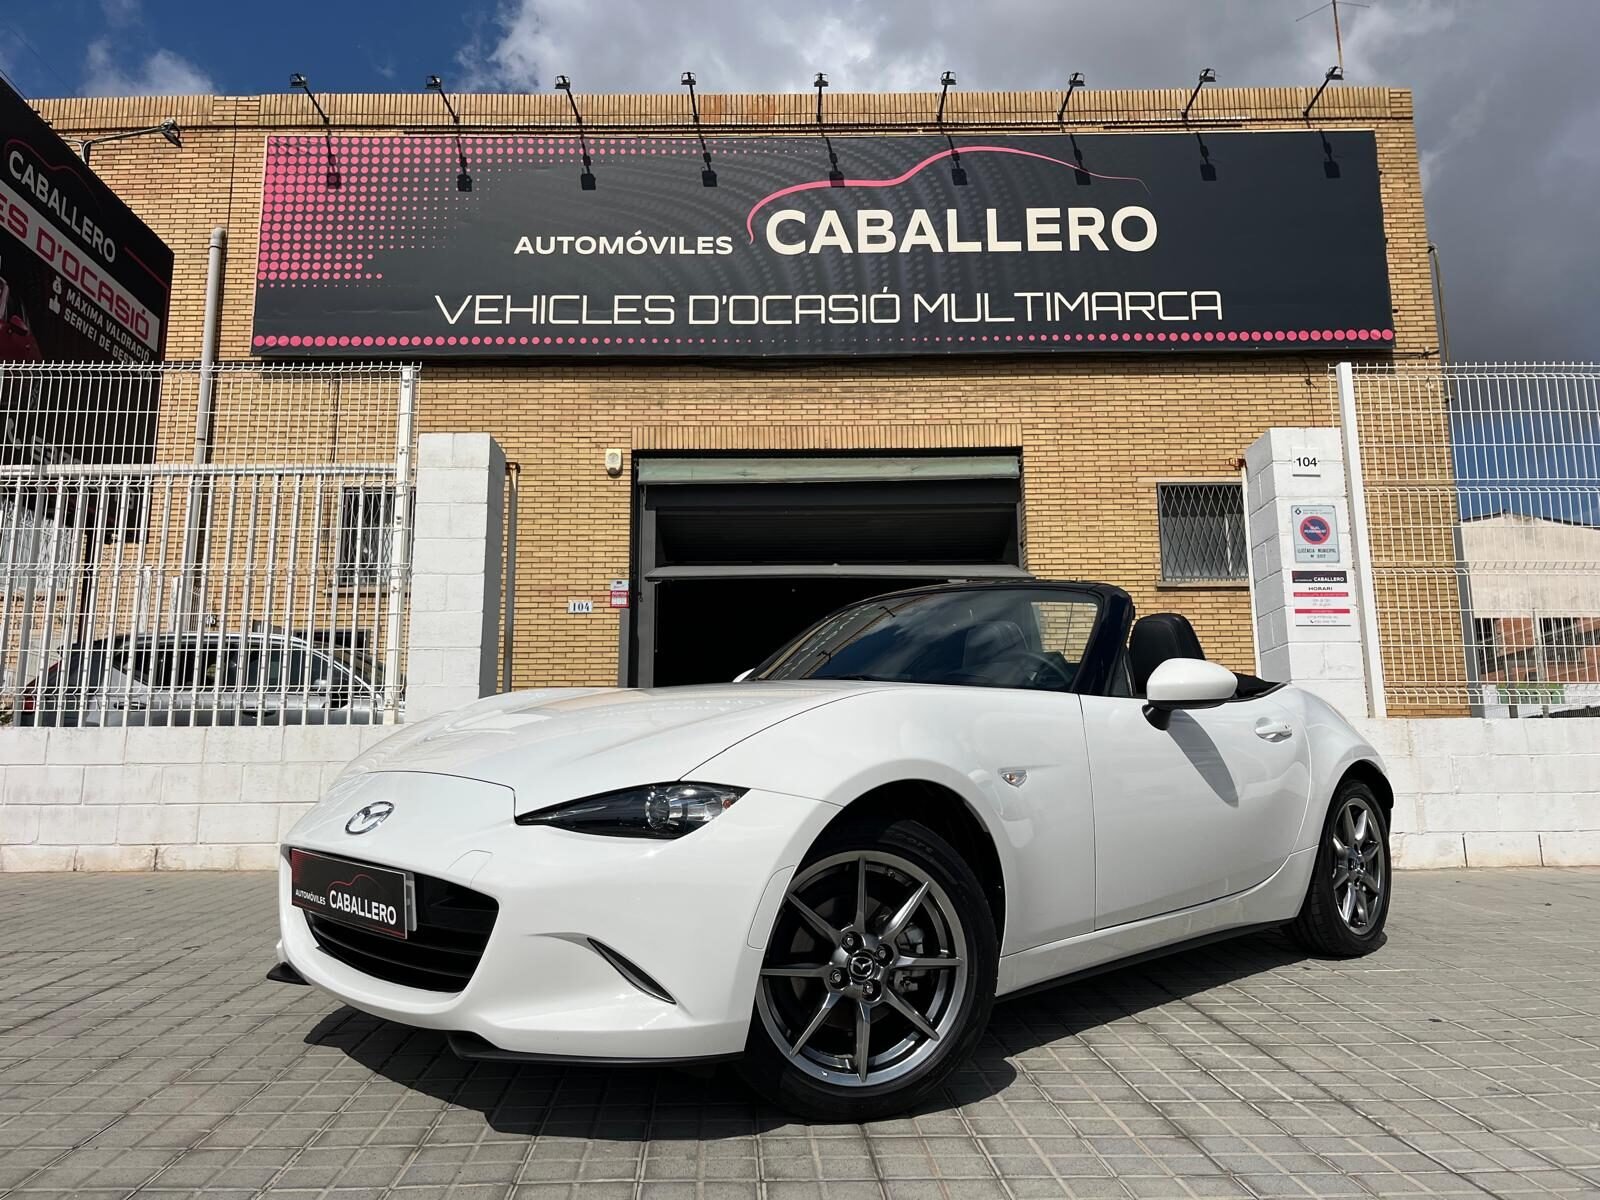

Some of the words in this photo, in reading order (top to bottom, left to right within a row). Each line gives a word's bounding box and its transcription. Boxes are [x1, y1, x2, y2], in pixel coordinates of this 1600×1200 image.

[9, 151, 116, 263] CABALLERO
[514, 230, 733, 255] AUTOMÓVILES
[766, 206, 1158, 255] CABALLERO
[36, 225, 150, 341] D'OCASIÓ
[435, 295, 675, 325] VEHICLES
[688, 286, 901, 325] D'OCASIÓ
[914, 290, 1222, 323] MULTIMARCA
[64, 308, 97, 342] SERVEI
[99, 334, 111, 352] DE
[106, 319, 150, 363] VALORACIÓ
[1296, 457, 1318, 467] 104
[572, 602, 590, 612] 104
[295, 888, 326, 905] AUTOMÓVILES
[329, 889, 397, 925] CABALLERO
